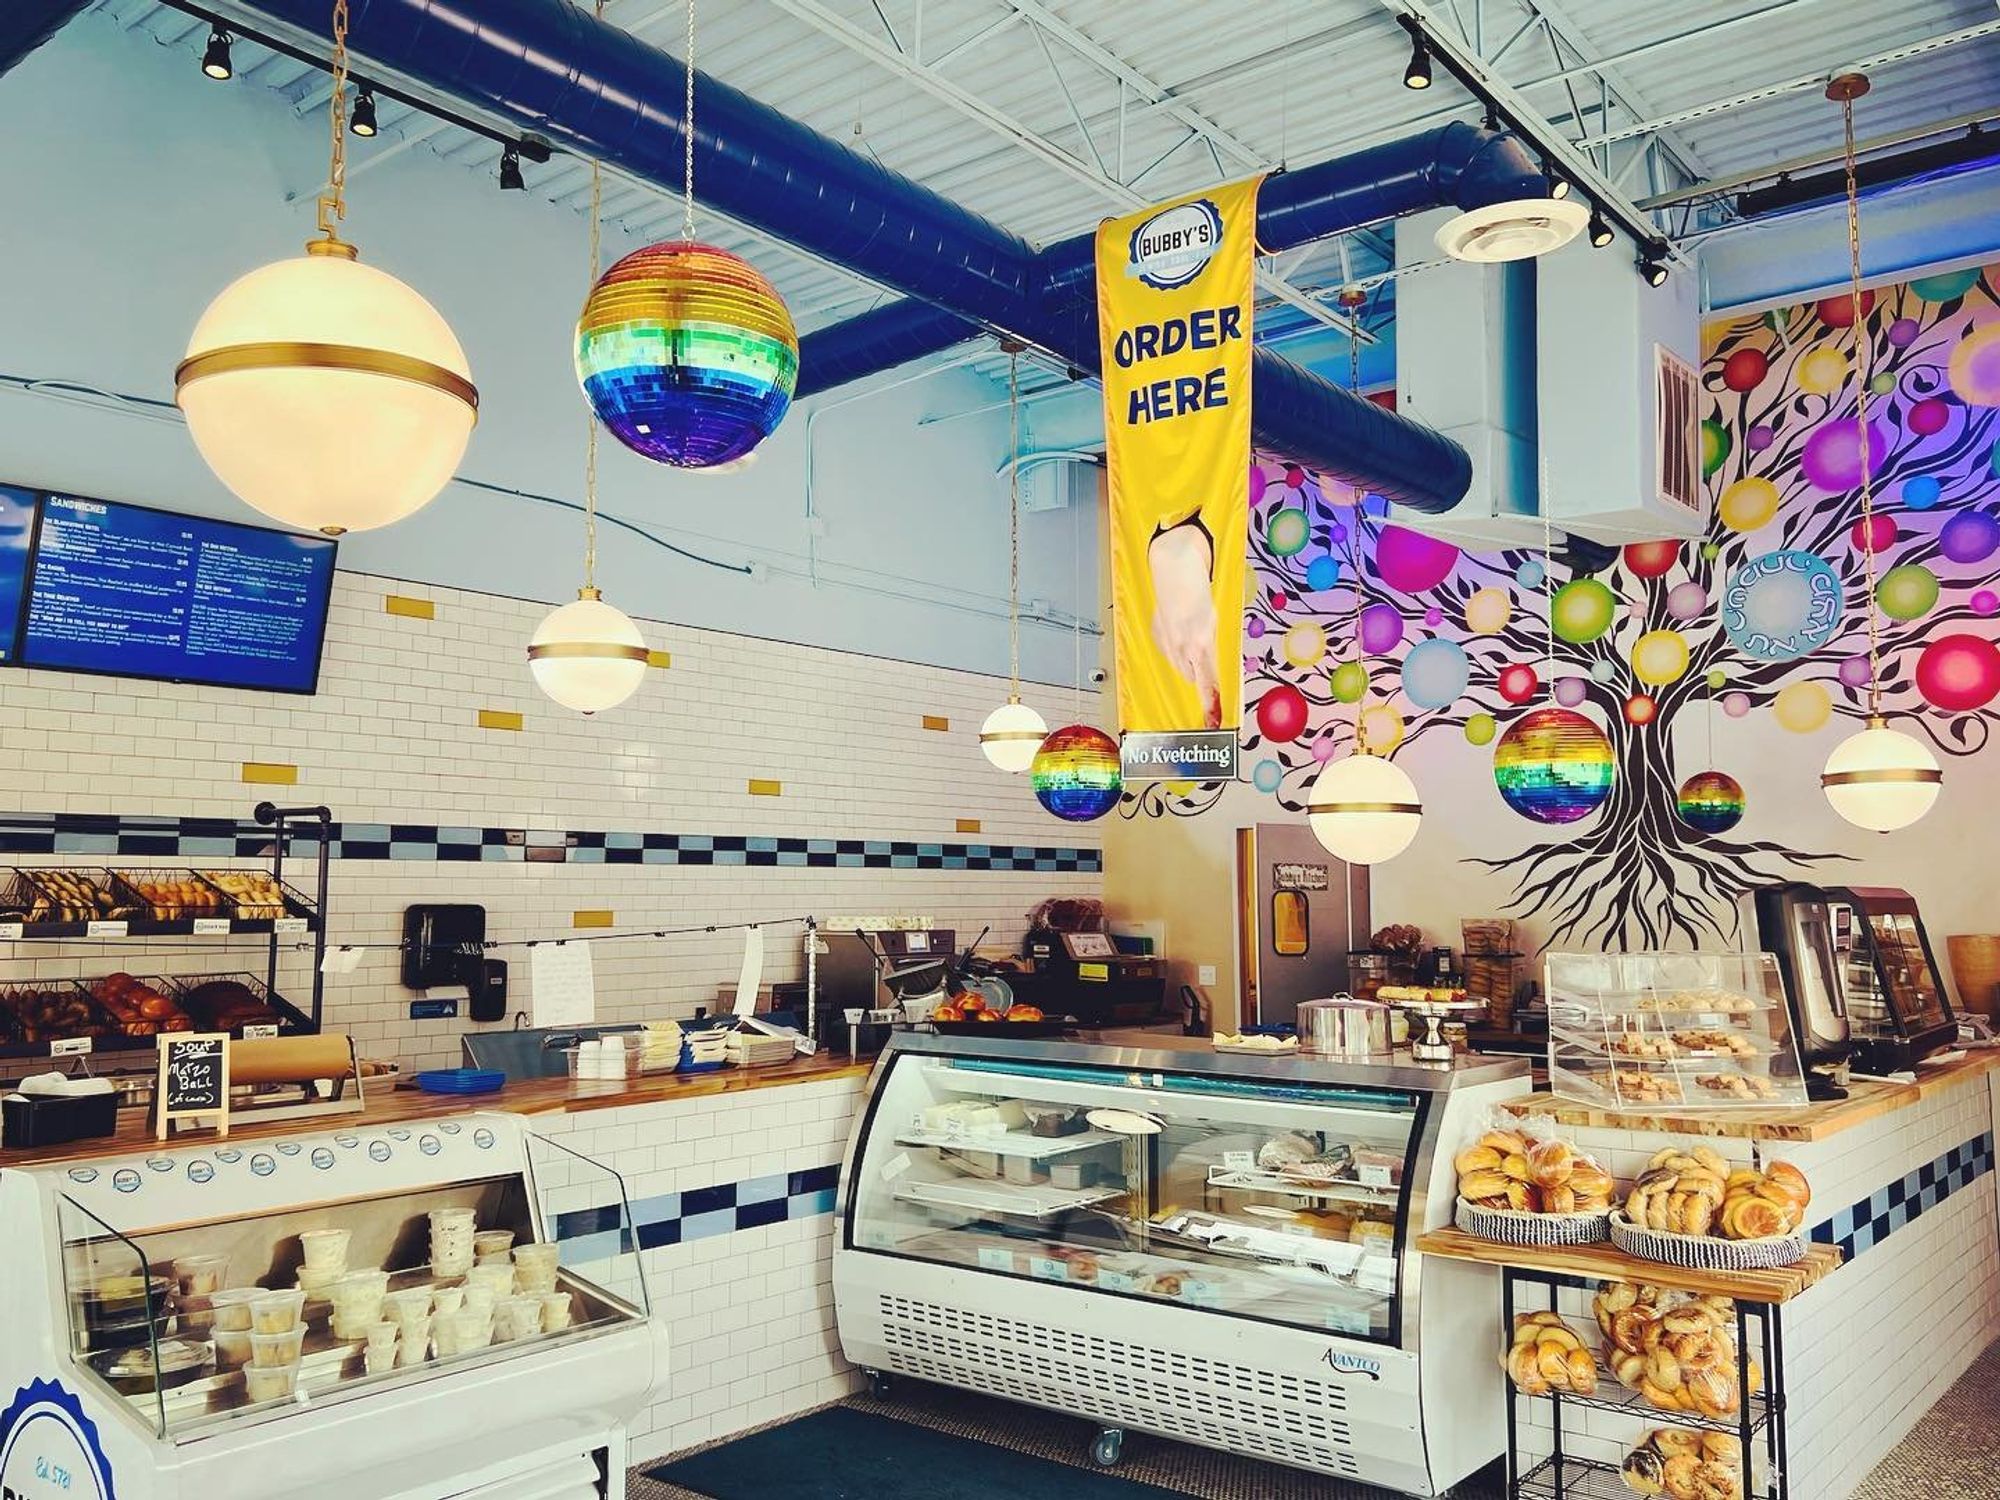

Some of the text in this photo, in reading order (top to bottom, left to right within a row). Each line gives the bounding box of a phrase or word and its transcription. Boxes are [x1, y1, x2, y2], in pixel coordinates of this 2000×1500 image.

[1142, 223, 1210, 257] BUBBY'S
[1114, 305, 1242, 369] ORDER
[1127, 367, 1229, 425] HERE
[50, 496, 107, 515] SANDWICHES
[1128, 743, 1231, 768] No Kvetching
[1321, 1347, 1381, 1374] AVANTCO
